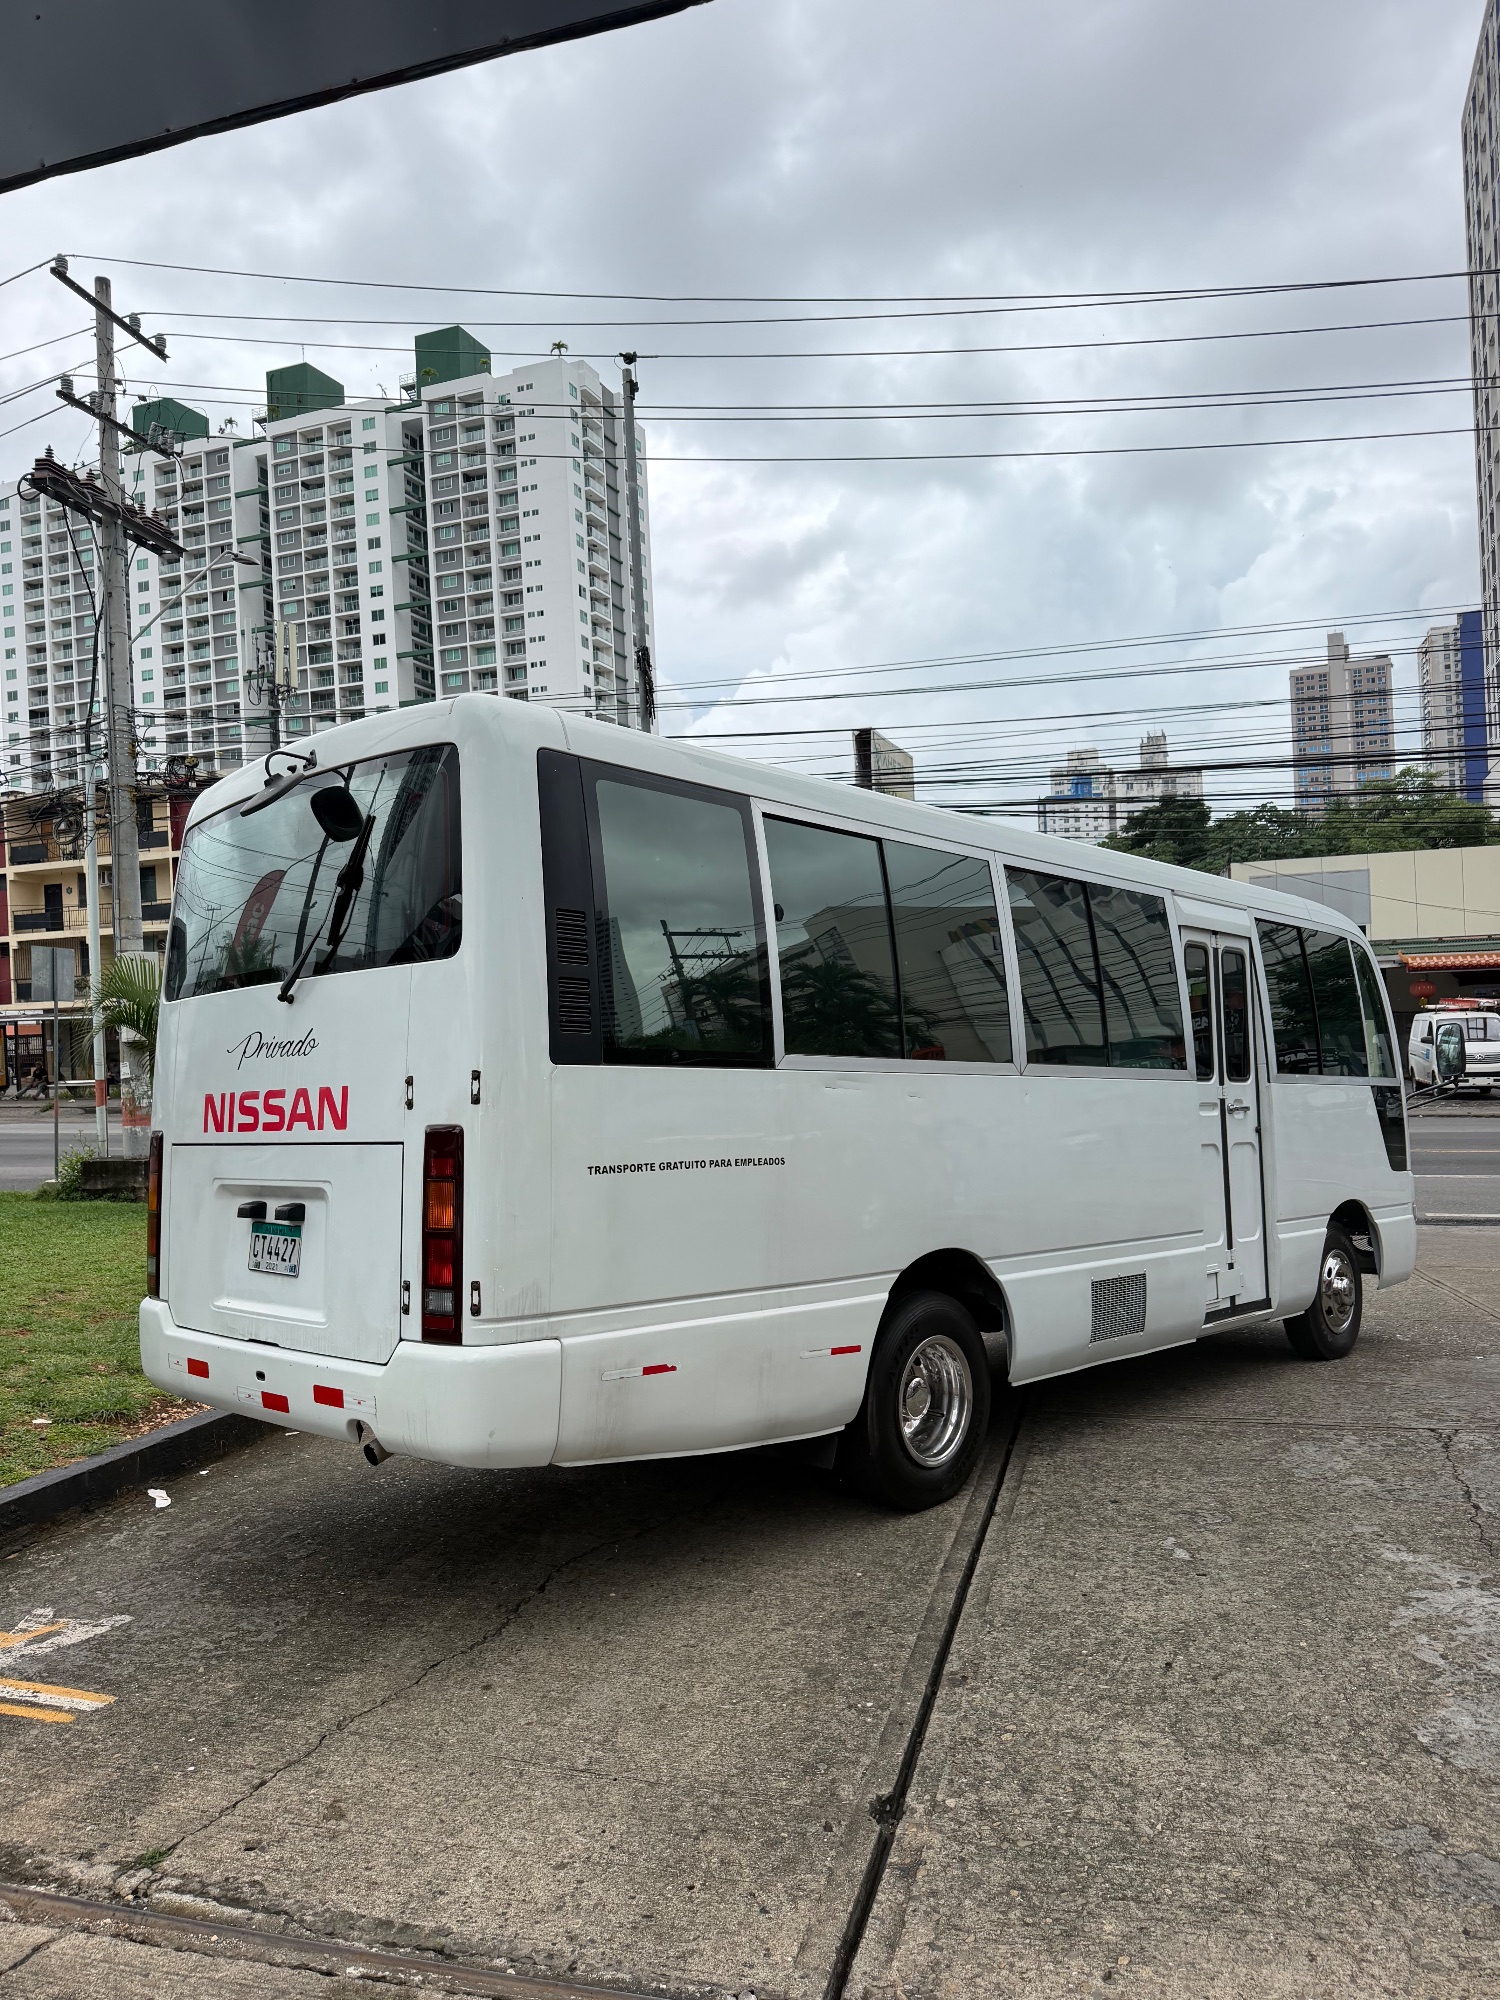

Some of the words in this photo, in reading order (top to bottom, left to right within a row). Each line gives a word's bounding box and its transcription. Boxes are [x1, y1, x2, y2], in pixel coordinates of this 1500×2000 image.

[227, 1028, 319, 1070] Privado
[203, 1085, 349, 1133] NISSAN
[587, 1164, 656, 1175] TRANSPORTE
[658, 1159, 707, 1171] GRATUITO
[709, 1158, 732, 1168] PARA
[734, 1157, 786, 1167] EMPLEADOS
[252, 1234, 297, 1262] CT4427
[265, 1261, 278, 1270] 2021
